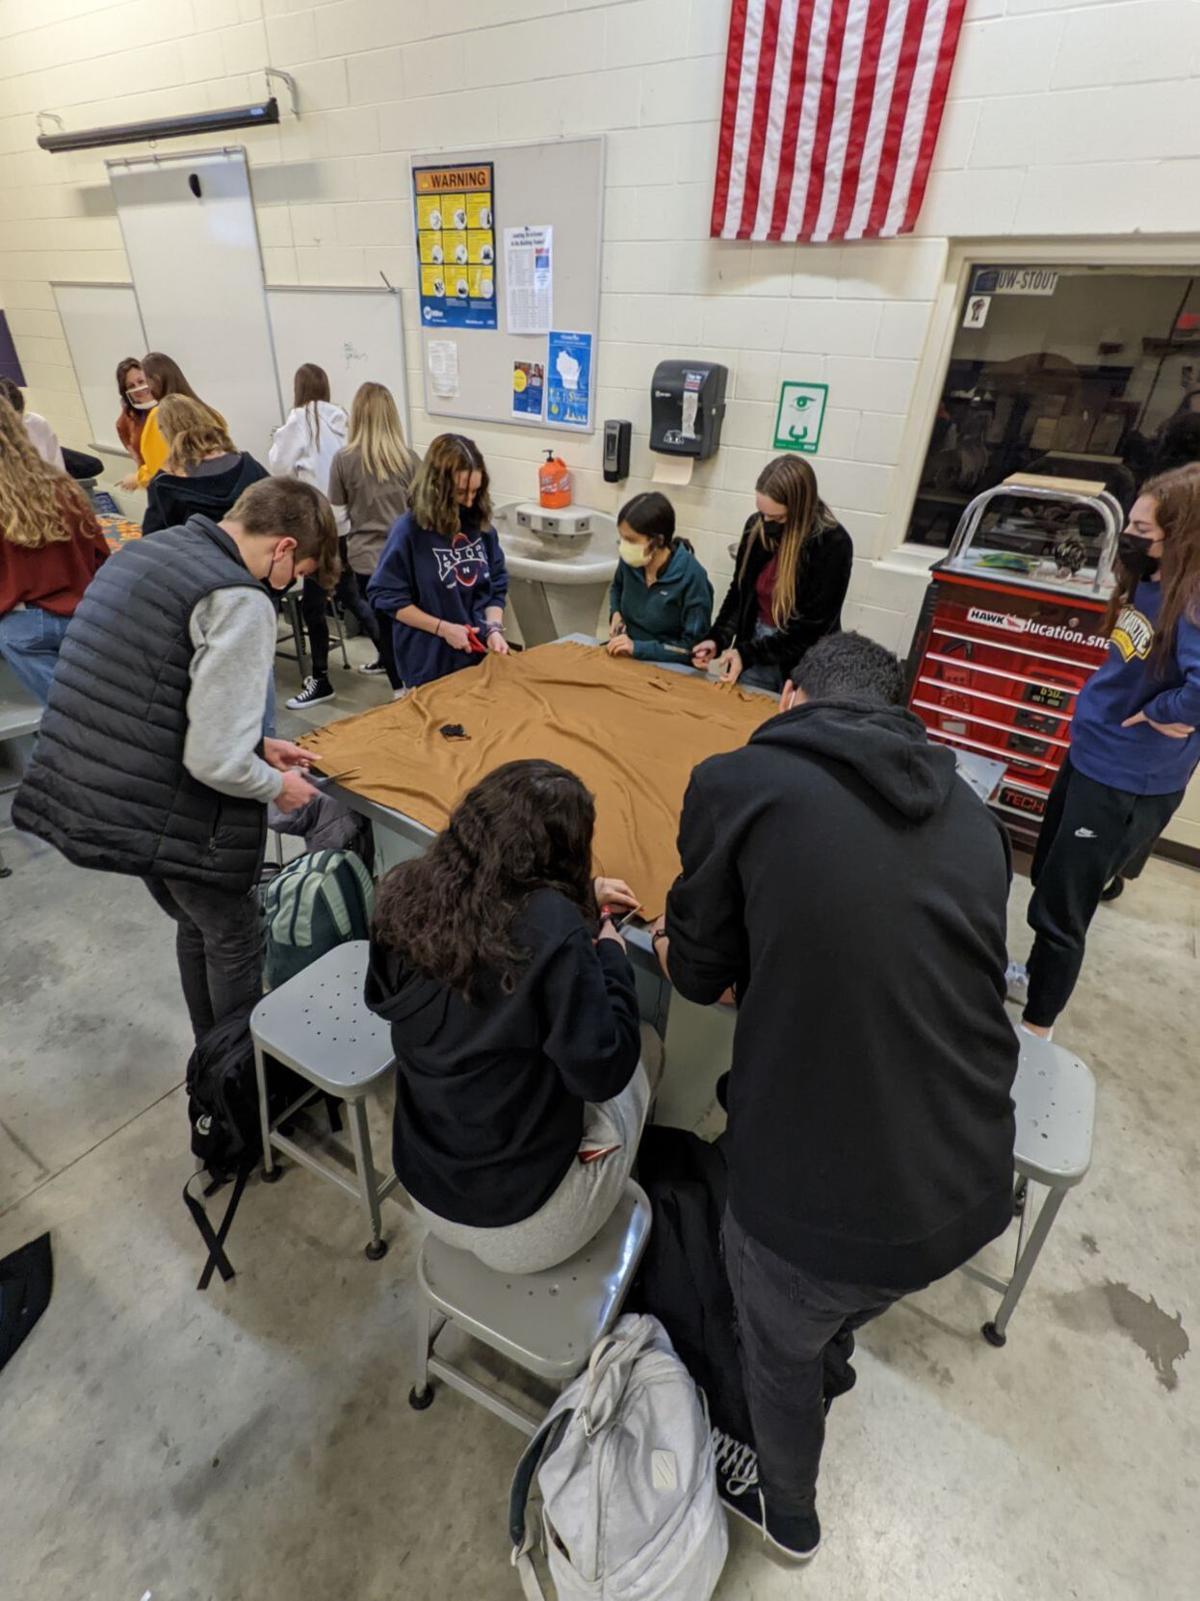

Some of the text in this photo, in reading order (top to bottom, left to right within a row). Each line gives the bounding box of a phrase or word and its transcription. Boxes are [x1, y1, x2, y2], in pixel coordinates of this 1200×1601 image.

[430, 171, 487, 189] WARNING
[998, 271, 1058, 290] UW-STOUT
[970, 610, 1005, 625] HAWK
[1023, 616, 1111, 650] ducation.sna
[1004, 790, 1045, 814] TECH
